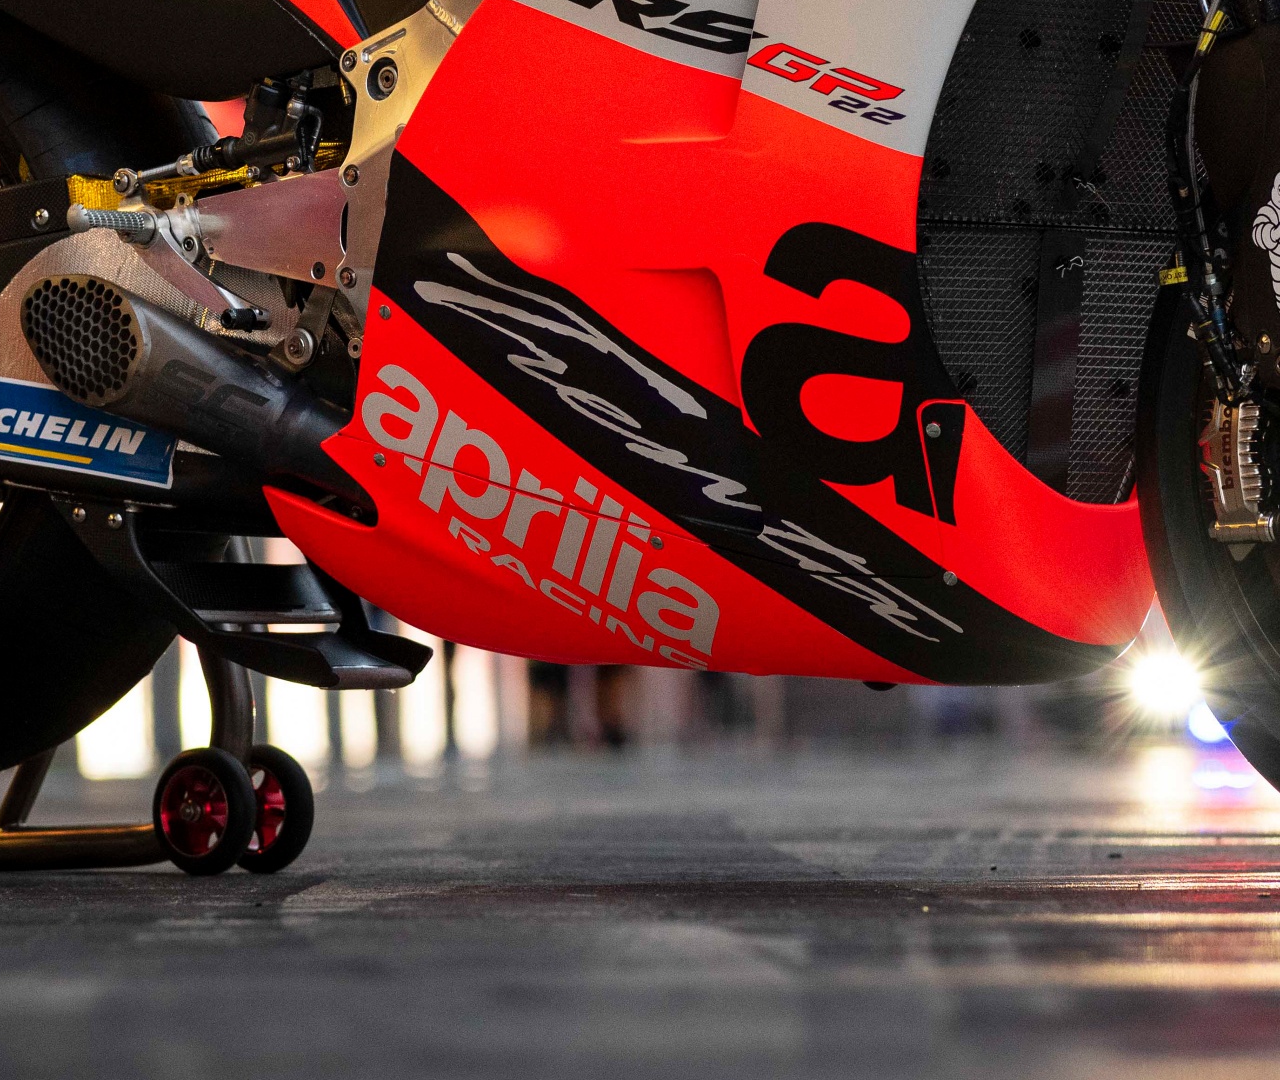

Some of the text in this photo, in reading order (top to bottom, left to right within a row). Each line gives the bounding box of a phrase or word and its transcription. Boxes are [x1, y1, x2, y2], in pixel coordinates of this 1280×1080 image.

[828, 95, 907, 125] 22
[1220, 406, 1235, 490] brembo
[362, 363, 721, 657] aprilia
